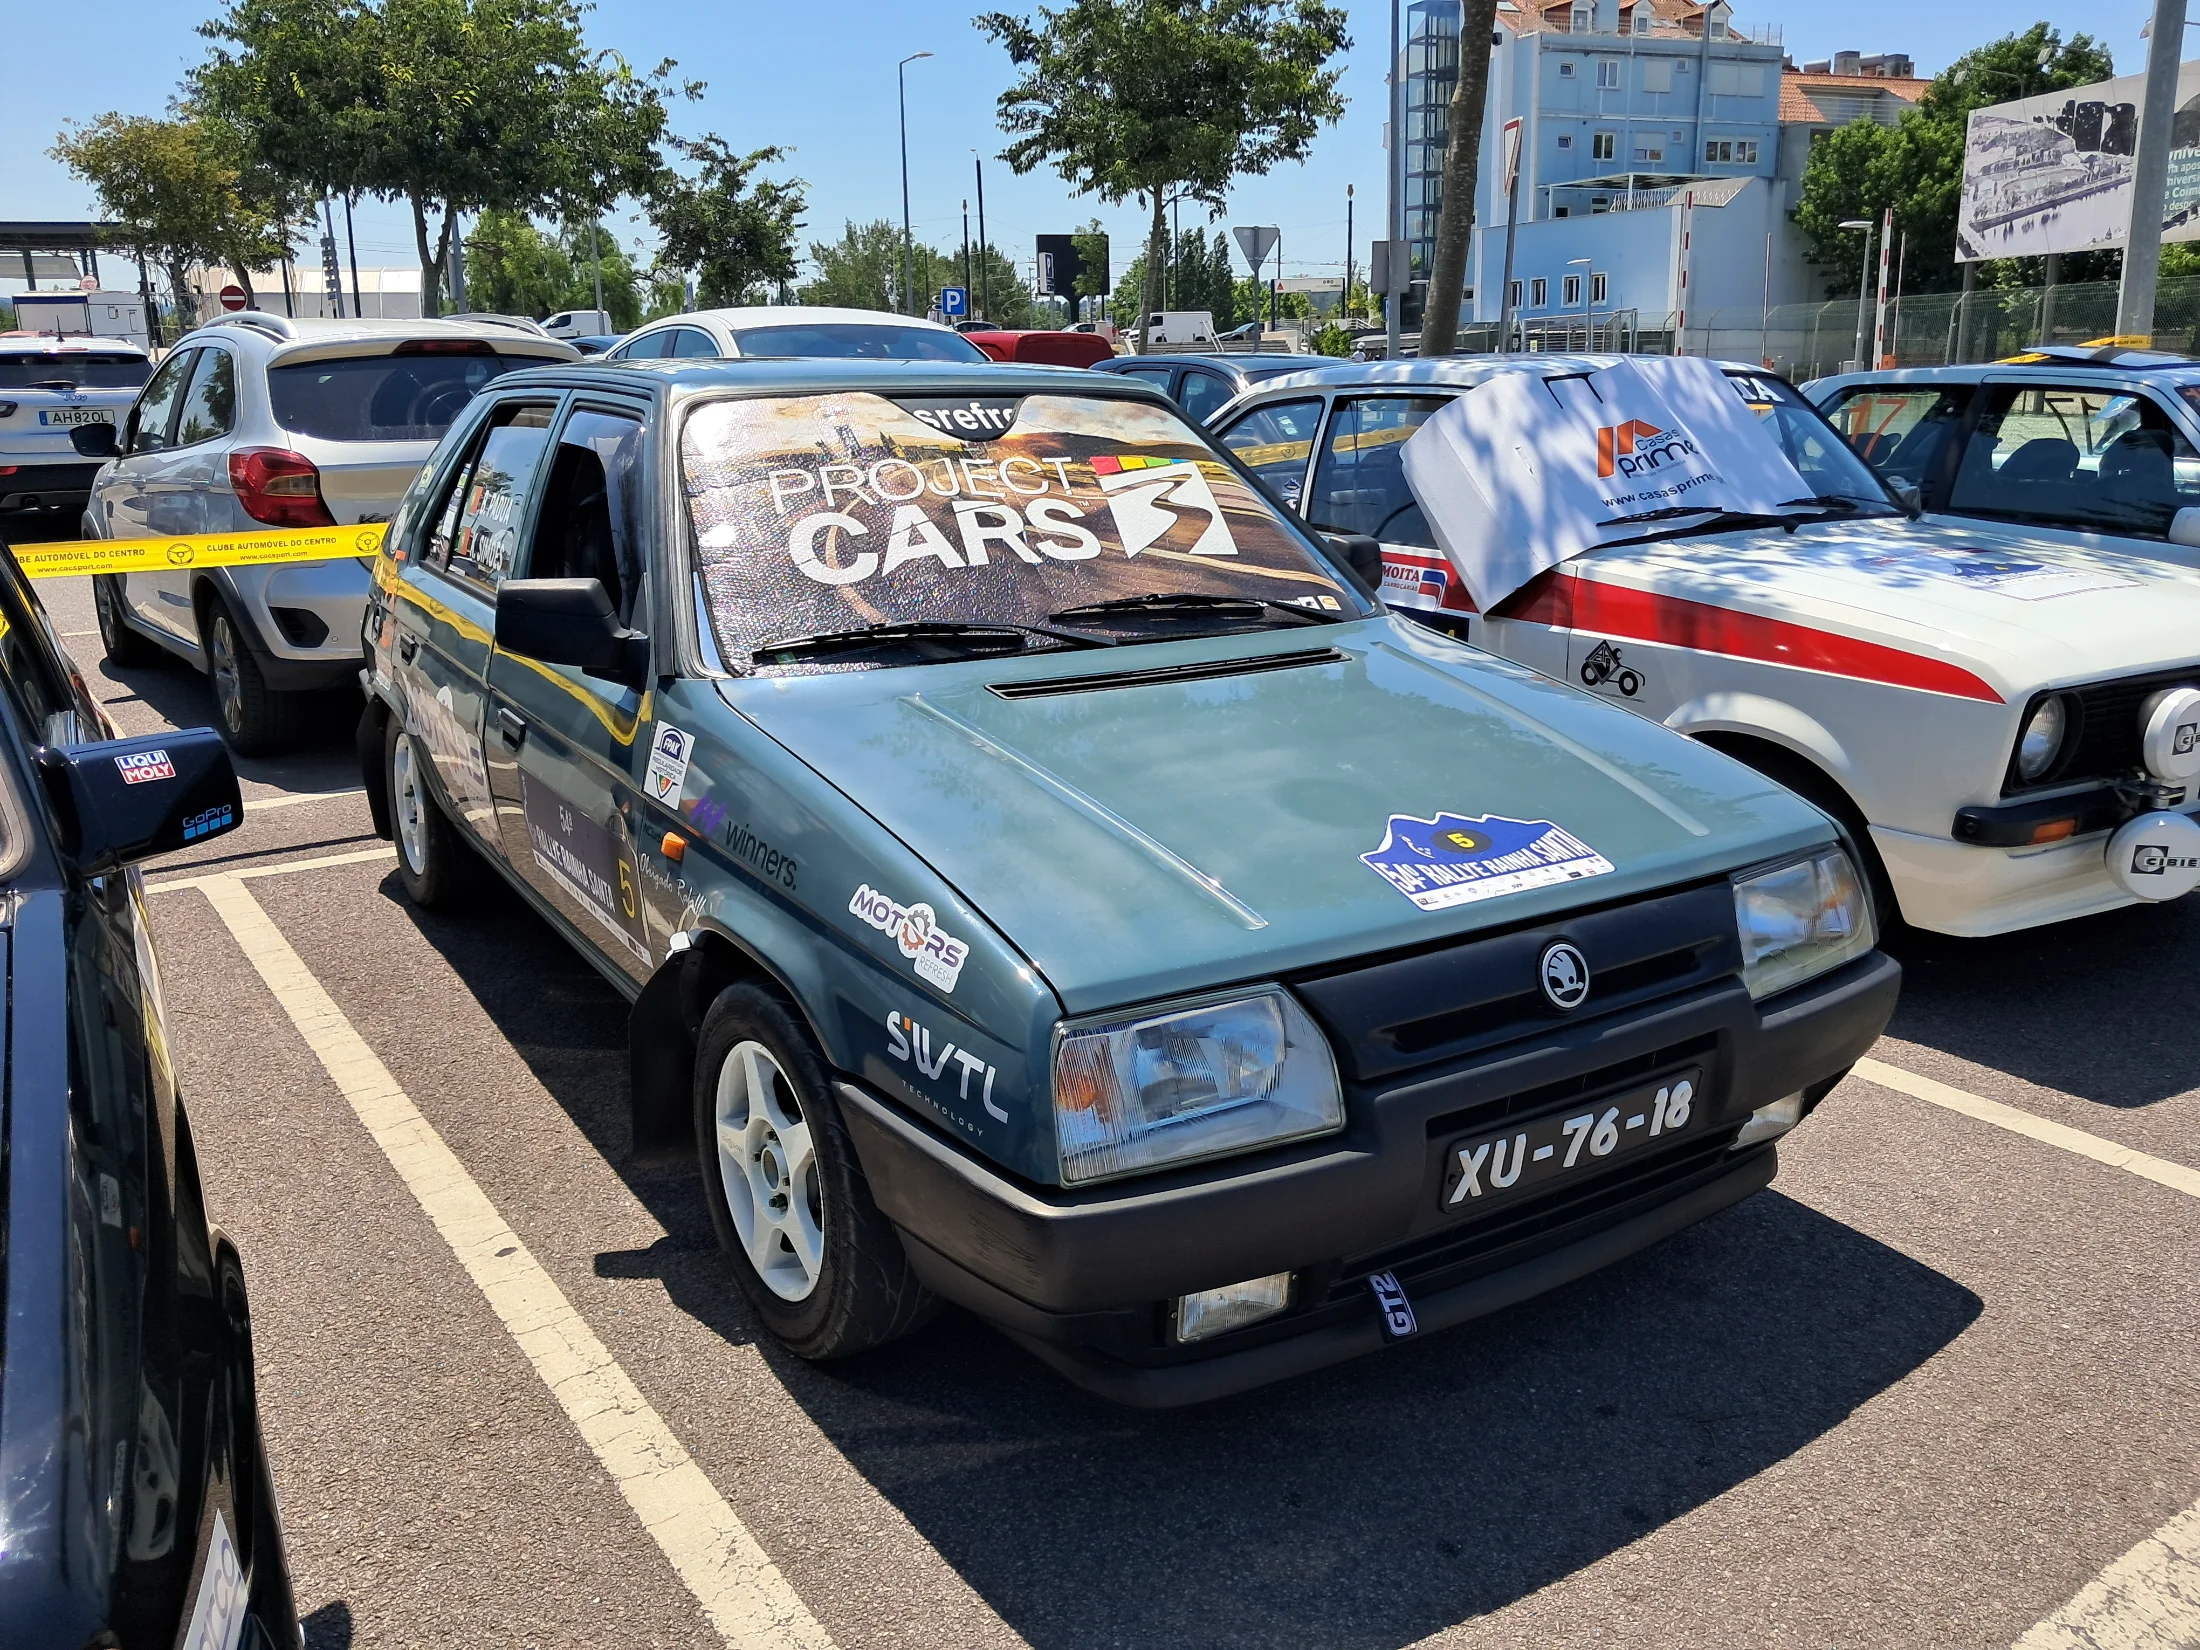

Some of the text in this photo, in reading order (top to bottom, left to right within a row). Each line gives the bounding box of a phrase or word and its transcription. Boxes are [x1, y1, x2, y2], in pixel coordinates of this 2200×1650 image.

[946, 290, 961, 313] P
[1634, 428, 1681, 451] Casas
[1617, 439, 1699, 479] prime
[768, 456, 1072, 515] PROJECT
[34, 551, 92, 563] AUTOMÓVEL
[93, 551, 106, 559] DO
[108, 548, 145, 558] CENTRO
[206, 537, 337, 552] CLUBE AUTOMÓVEL DO CENTRO
[788, 497, 1101, 586] CARS
[1382, 565, 1420, 582] MOITA
[119, 751, 167, 769] LIQUI
[662, 737, 681, 756] FPAK
[124, 763, 170, 782] MOLY
[182, 803, 232, 828] GoPro
[725, 820, 798, 891] winners.
[1446, 832, 1475, 849] 5
[1414, 861, 1492, 886] RALLYE
[1480, 847, 1548, 874] RAINHA
[1529, 828, 1594, 863] SANTA
[617, 858, 636, 919] 5
[853, 890, 963, 968] MOTORS
[918, 956, 953, 986] REFRESH
[901, 1080, 983, 1137] TECHNOLOGY
[1448, 1079, 1694, 1204] XU-76-18
[1369, 1273, 1413, 1335] GT2
